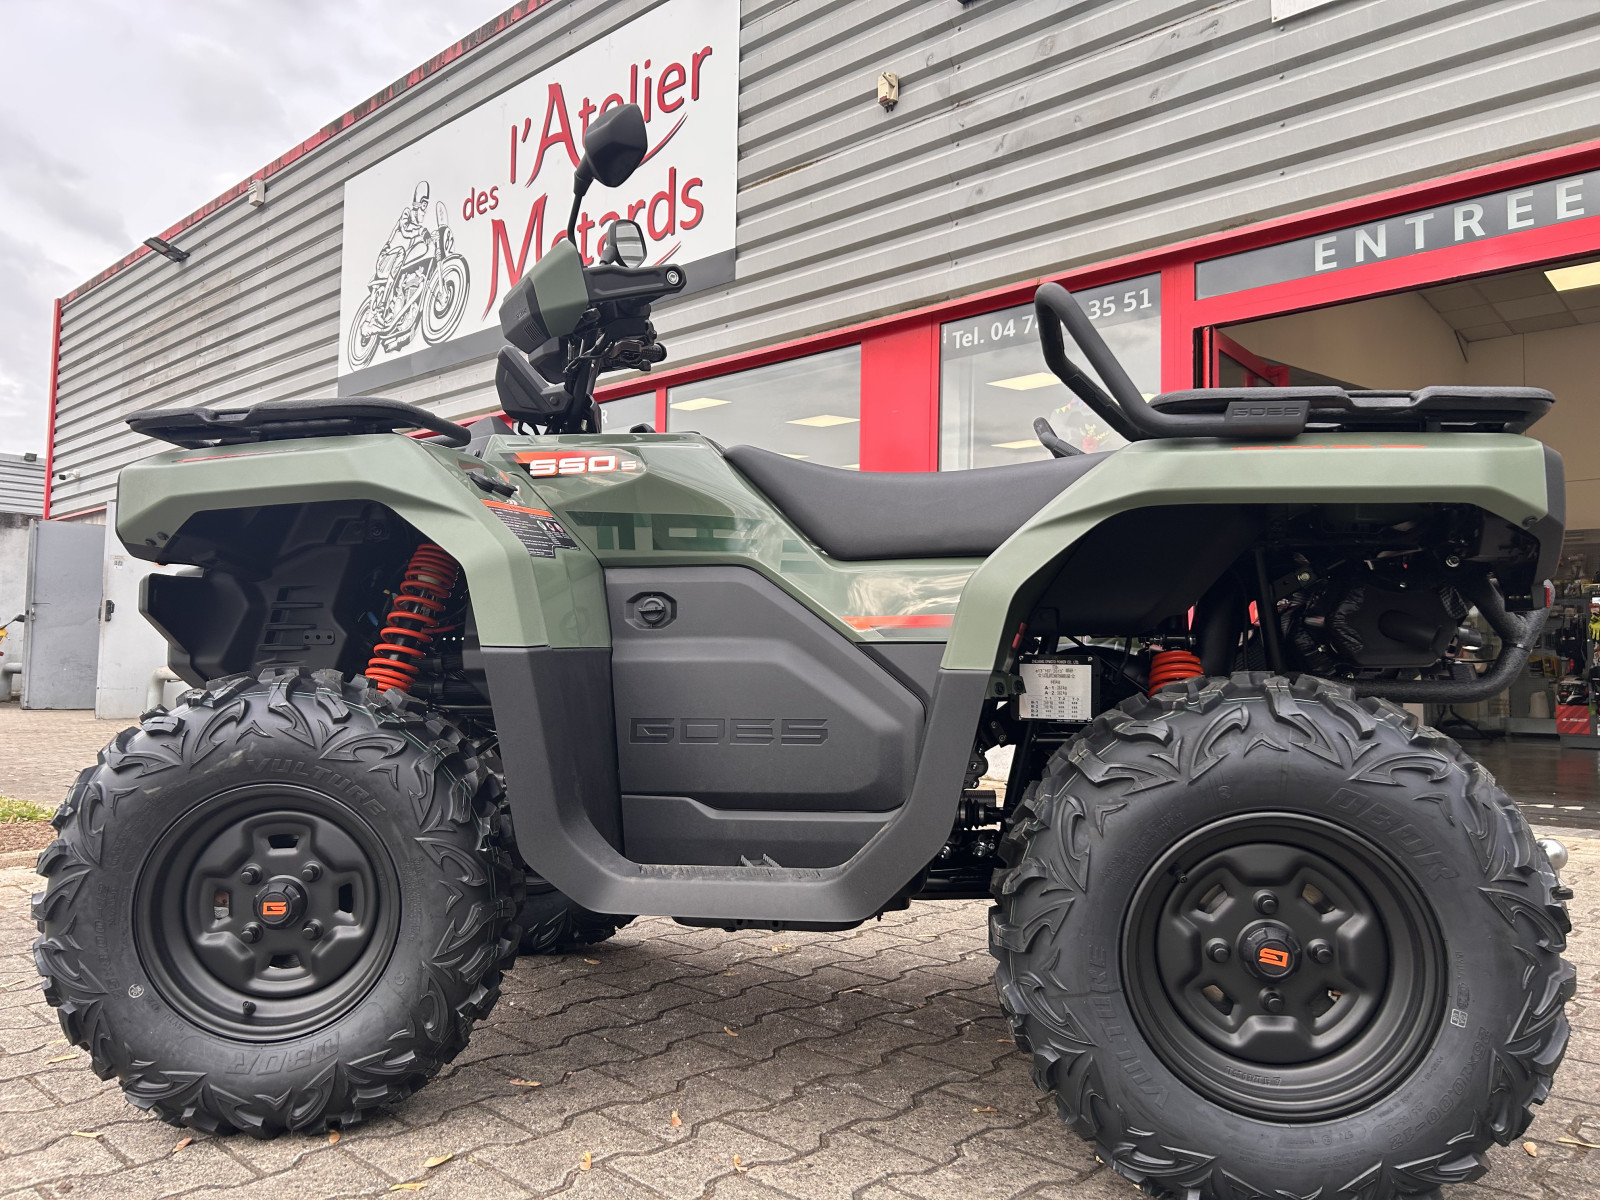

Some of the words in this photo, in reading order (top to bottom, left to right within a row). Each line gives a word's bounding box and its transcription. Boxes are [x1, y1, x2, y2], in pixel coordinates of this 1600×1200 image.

[462, 185, 499, 221] des
[1314, 179, 1585, 272] ENTREE
[481, 166, 704, 321] Mtards
[952, 326, 985, 349] Tel.
[990, 318, 1016, 342] 04
[1021, 314, 1040, 335] 7
[1087, 295, 1116, 320] 35
[1123, 288, 1152, 313] 51
[1231, 406, 1301, 418] GOES
[629, 717, 829, 746] GOES
[246, 757, 387, 817] VULTURE
[1325, 787, 1460, 881] OBOR
[1088, 941, 1169, 1111] VULTURE
